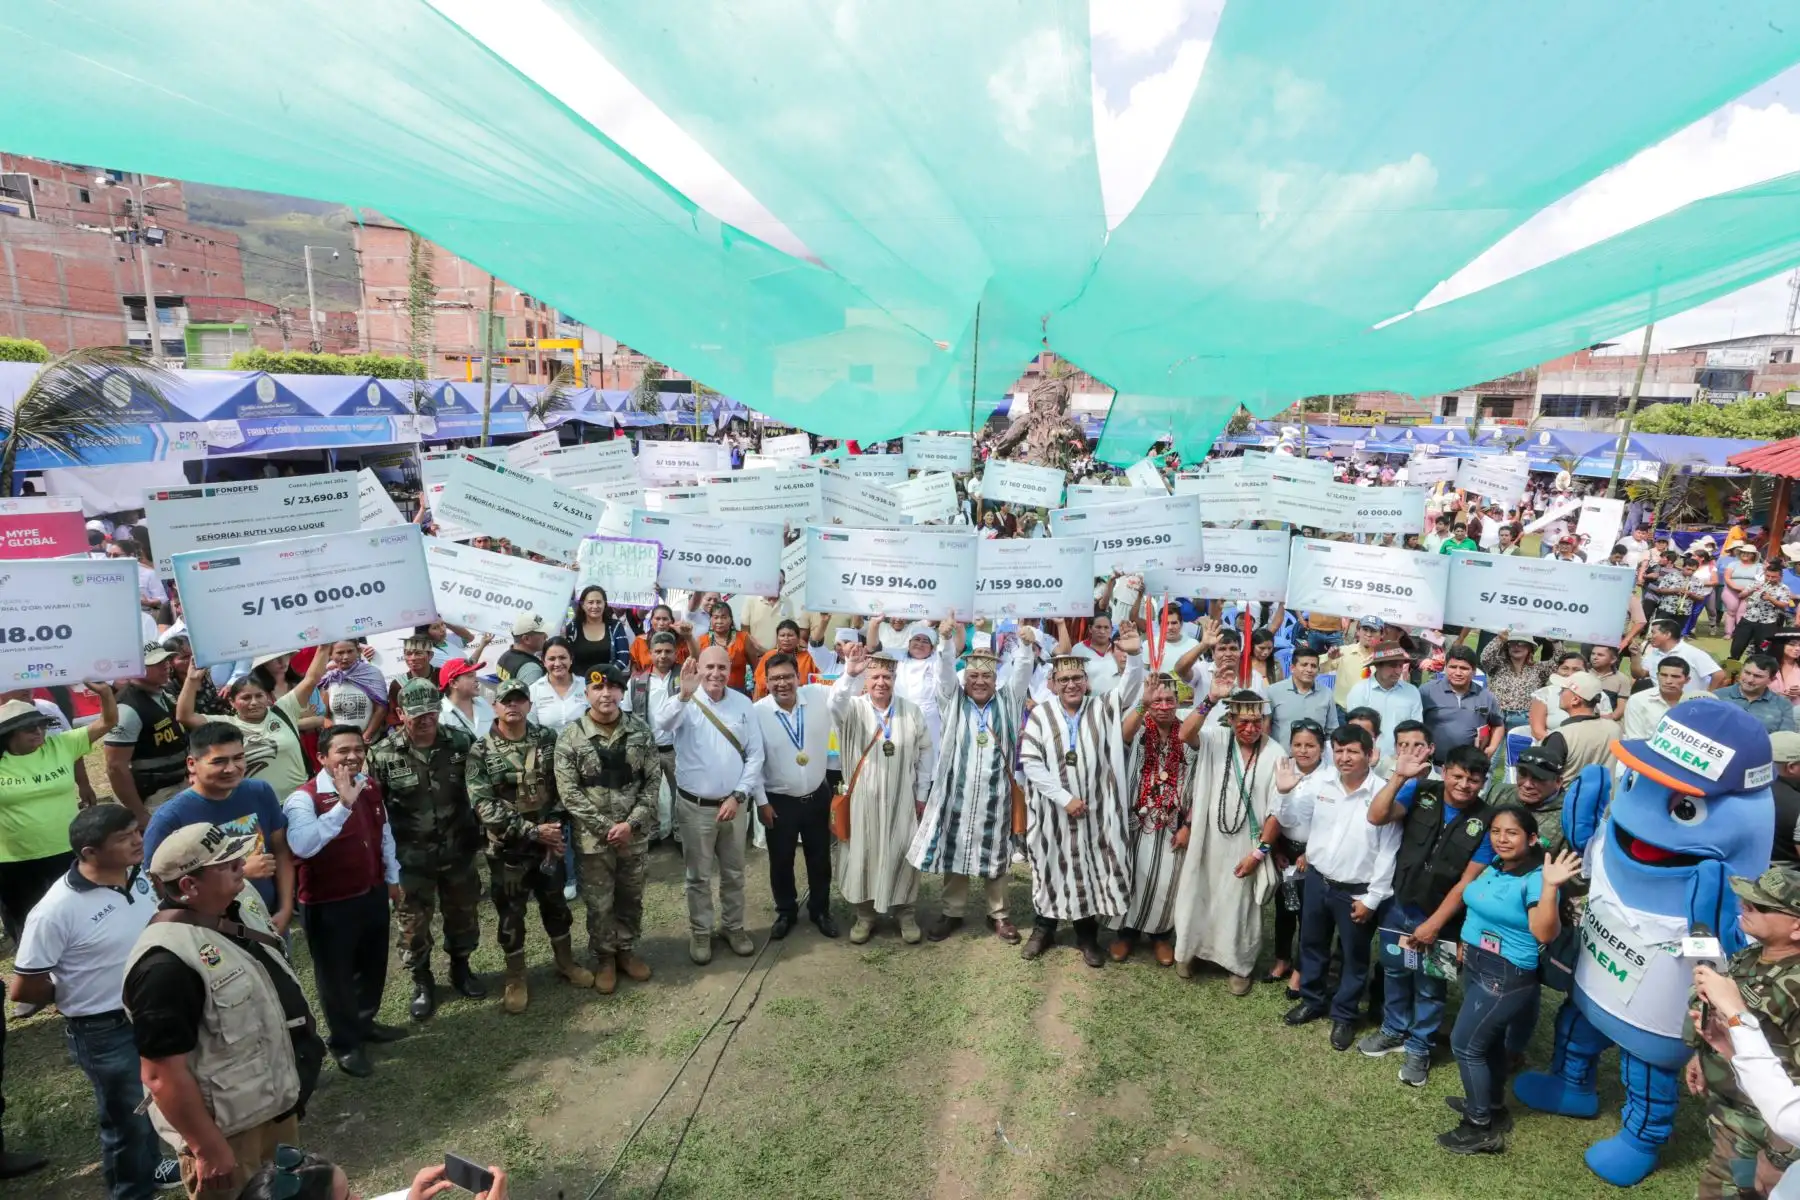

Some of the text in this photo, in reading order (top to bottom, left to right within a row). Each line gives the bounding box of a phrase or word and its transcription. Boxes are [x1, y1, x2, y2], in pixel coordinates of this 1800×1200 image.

[504, 468, 534, 484] FONDEPES
[216, 485, 259, 493] FONDEPES
[283, 491, 349, 506] S/ 23,690.83
[553, 502, 561, 510] S/
[6, 528, 39, 537] MYPE
[243, 529, 267, 538] RUTH
[8, 537, 57, 547] GLOBAL
[1102, 537, 1123, 549] 159
[1126, 533, 1172, 548] 996.90
[661, 549, 752, 567] S/ 350 000.00
[1214, 563, 1258, 574] 980.00
[86, 574, 125, 583] PICHARI
[841, 572, 937, 590] S/ 159 914.00
[989, 579, 1012, 590] 159
[1016, 578, 1063, 589] 980.00
[1323, 575, 1413, 597] S/ 159 985.00
[242, 597, 264, 616] S/
[270, 593, 308, 611] 160
[314, 580, 386, 604] 000.00
[439, 580, 534, 611] S/ 160 000.00
[1480, 591, 1589, 614] S/ 350 000.00
[28, 663, 54, 671] PRO
[1665, 724, 1724, 758] FONDEPES
[1653, 736, 1710, 771] VRAEM
[32, 764, 70, 784] WARMI
[1585, 907, 1646, 966] FONDEPES
